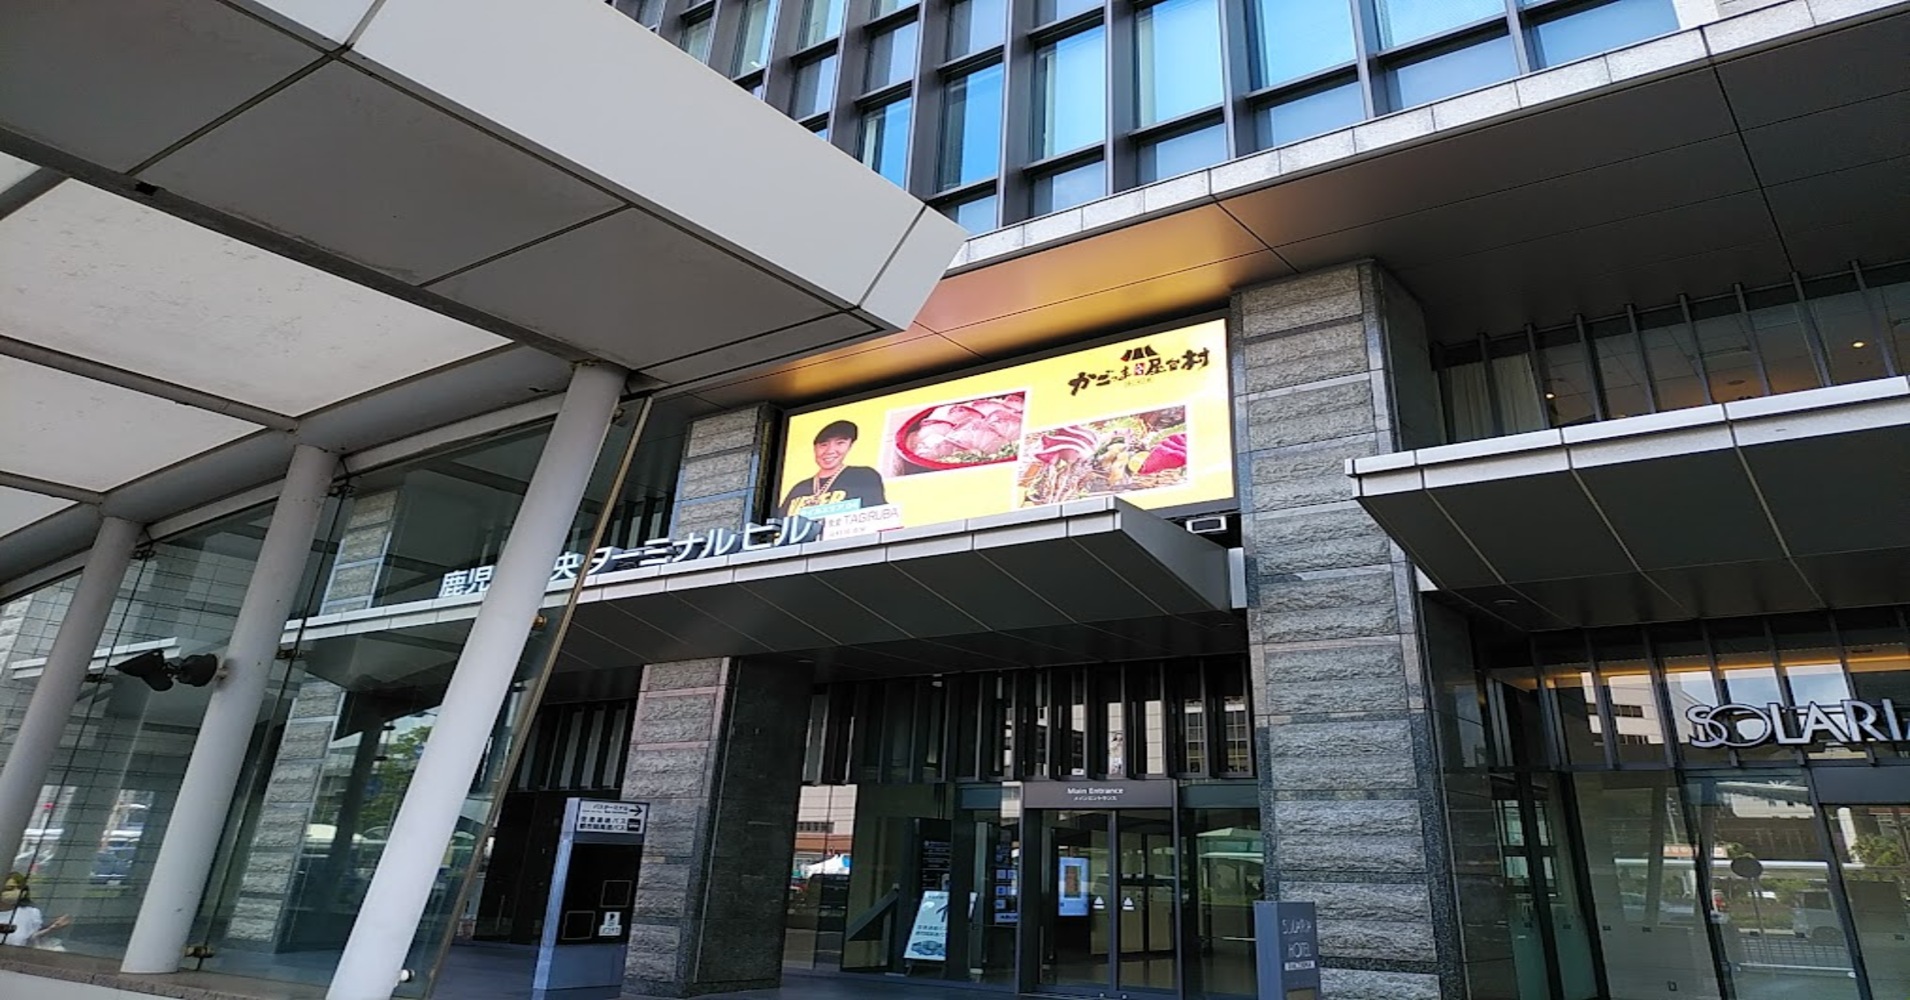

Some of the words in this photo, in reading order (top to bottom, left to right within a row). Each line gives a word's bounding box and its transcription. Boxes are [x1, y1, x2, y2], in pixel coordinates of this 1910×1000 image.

[1686, 699, 1910, 748] SOLARI
[1067, 787, 1087, 795] Main
[1088, 787, 1124, 795] Entrance
